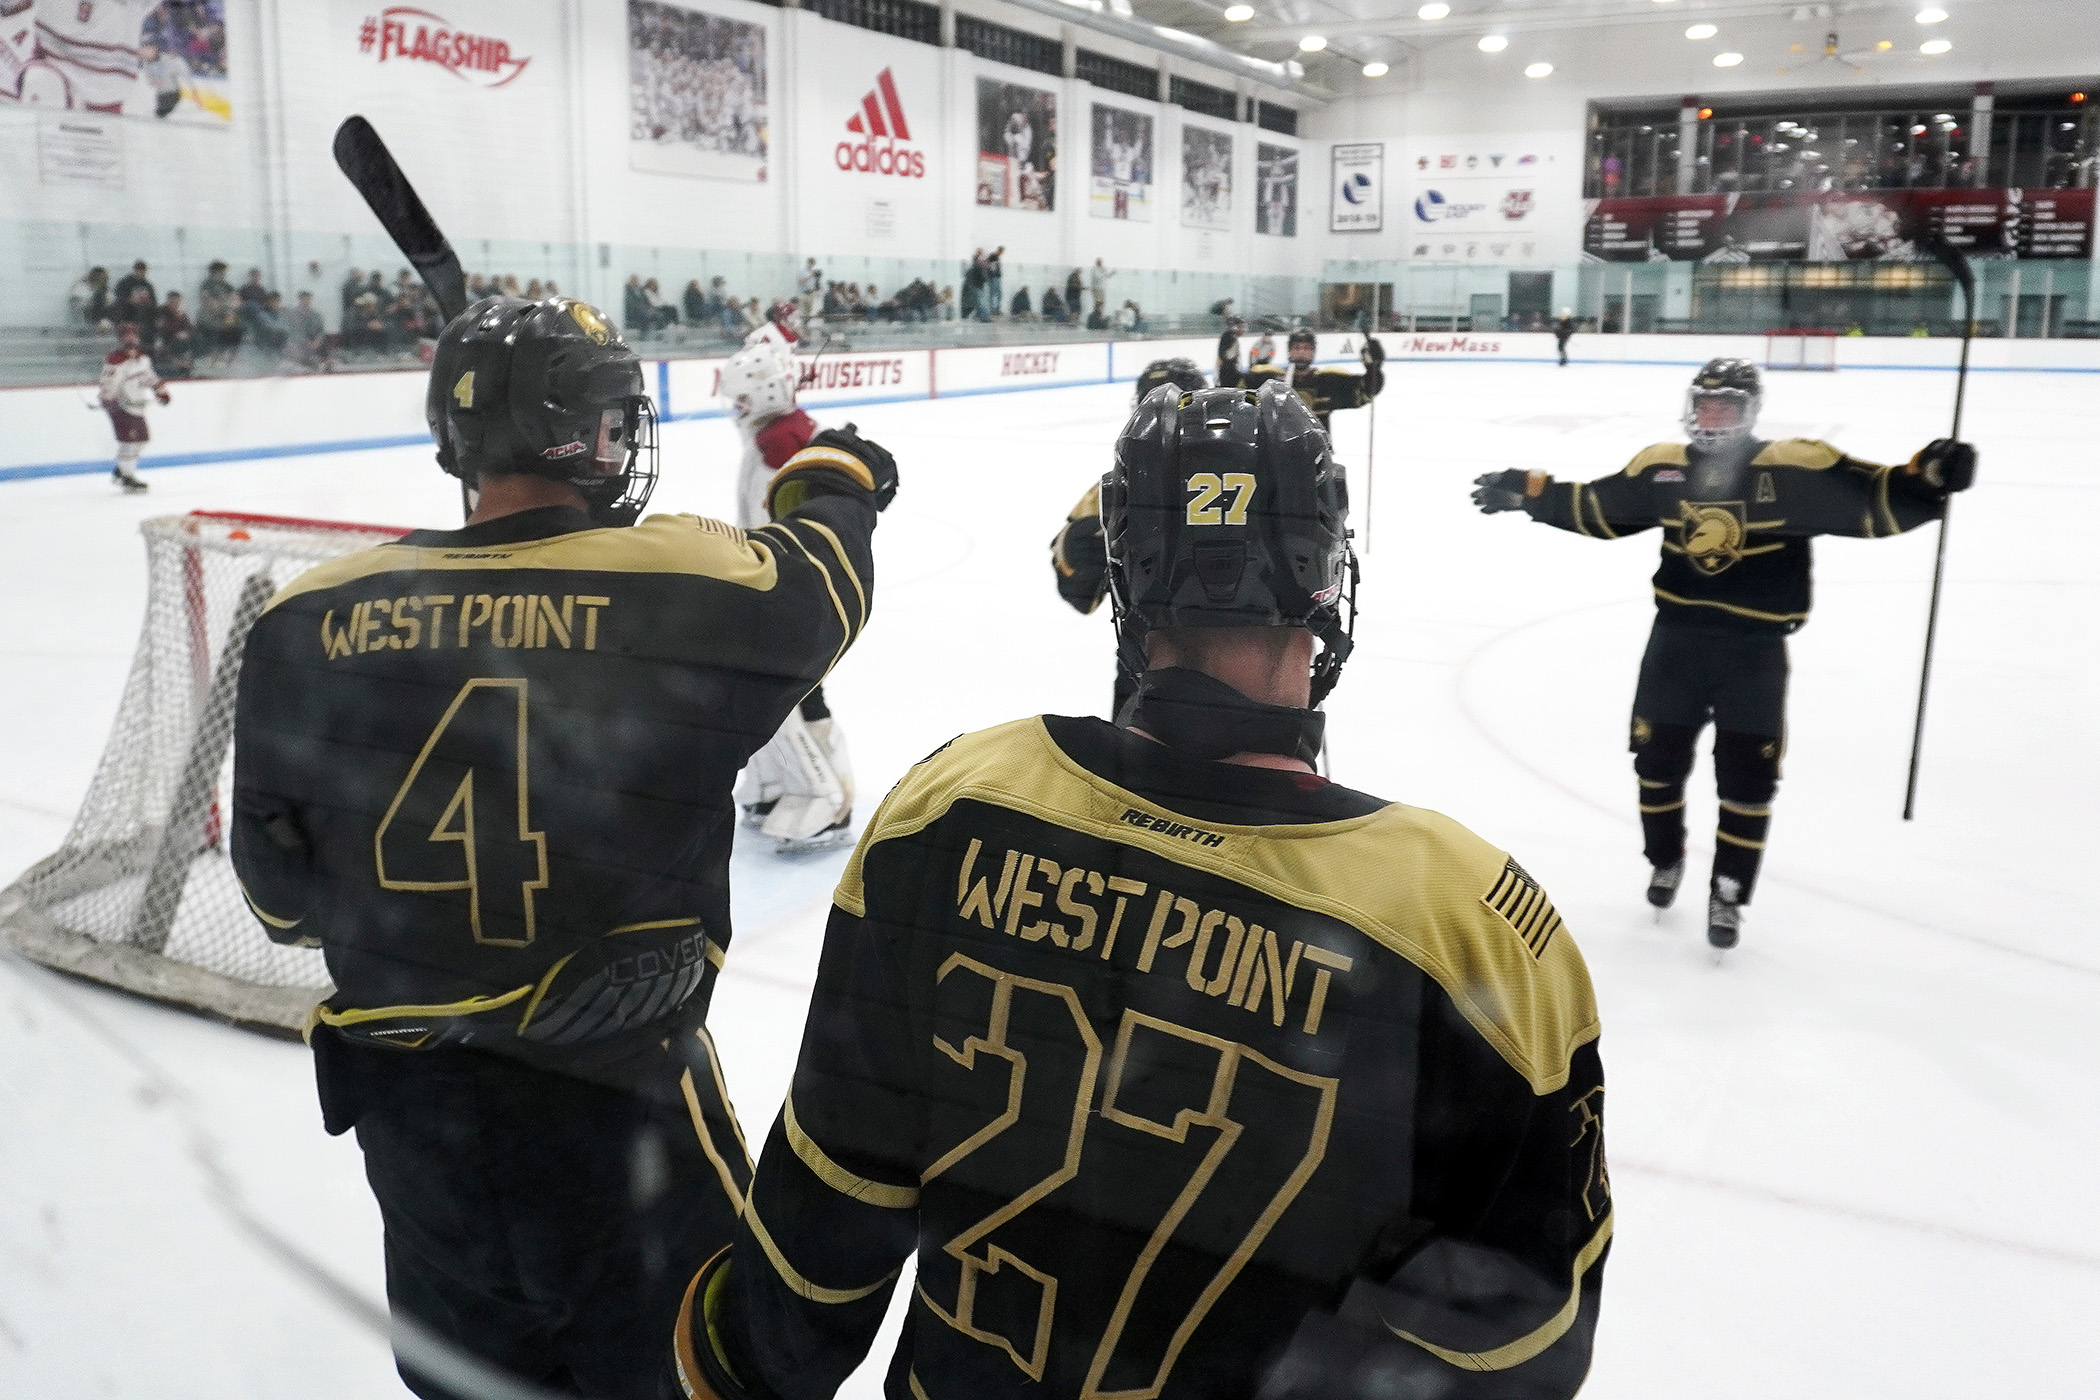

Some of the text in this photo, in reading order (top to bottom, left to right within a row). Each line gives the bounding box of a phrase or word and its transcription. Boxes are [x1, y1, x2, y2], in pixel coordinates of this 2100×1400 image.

[358, 16, 511, 74] #FLAGSHIP
[835, 134, 925, 180] adidas
[1001, 351, 1060, 377] HOCKEY
[1401, 337, 1501, 352] #NewMass
[453, 370, 475, 408] 4
[1186, 472, 1257, 526] 27
[320, 595, 611, 661] WEST POINT
[374, 677, 549, 948] 4
[1120, 808, 1226, 848] REBIRTH
[957, 838, 1354, 1035] WEST POINT
[920, 951, 1340, 1400] 27
